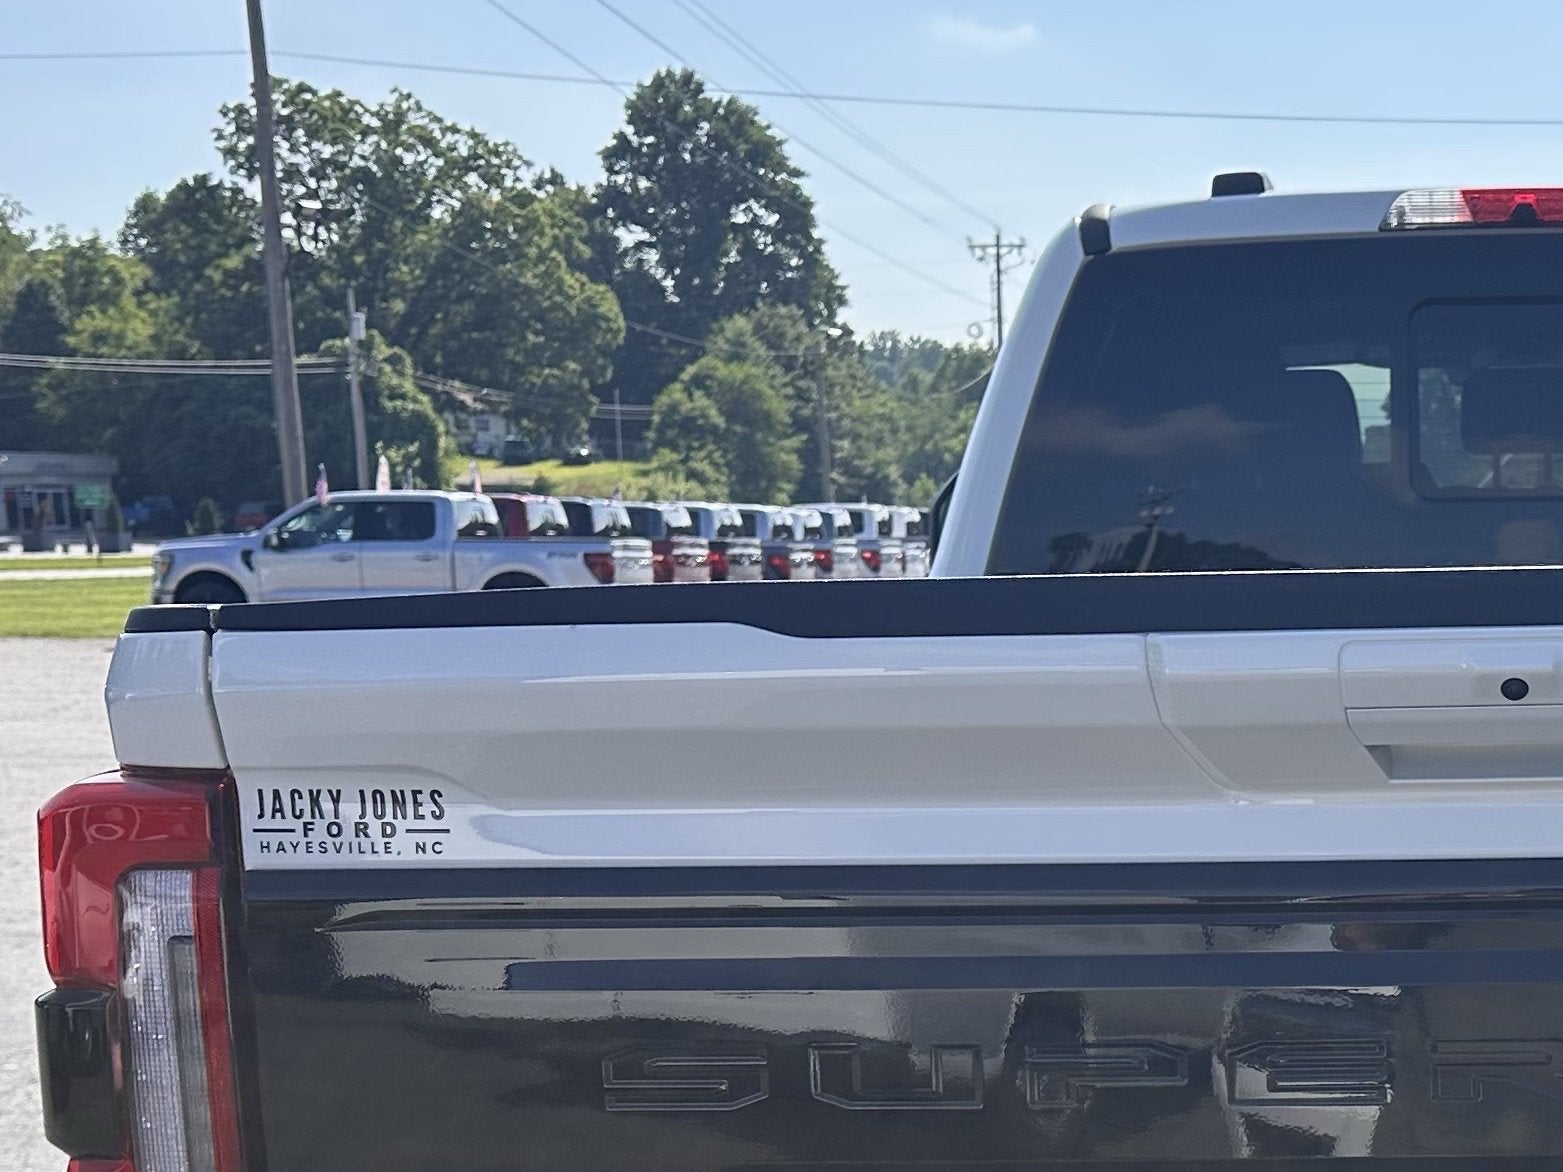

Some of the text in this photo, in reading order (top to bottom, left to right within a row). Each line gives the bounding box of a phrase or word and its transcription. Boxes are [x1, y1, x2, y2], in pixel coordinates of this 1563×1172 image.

[256, 788, 445, 820] JACKY JONES
[302, 821, 397, 838] FORD
[260, 841, 444, 856] HAYESVILLE, NC
